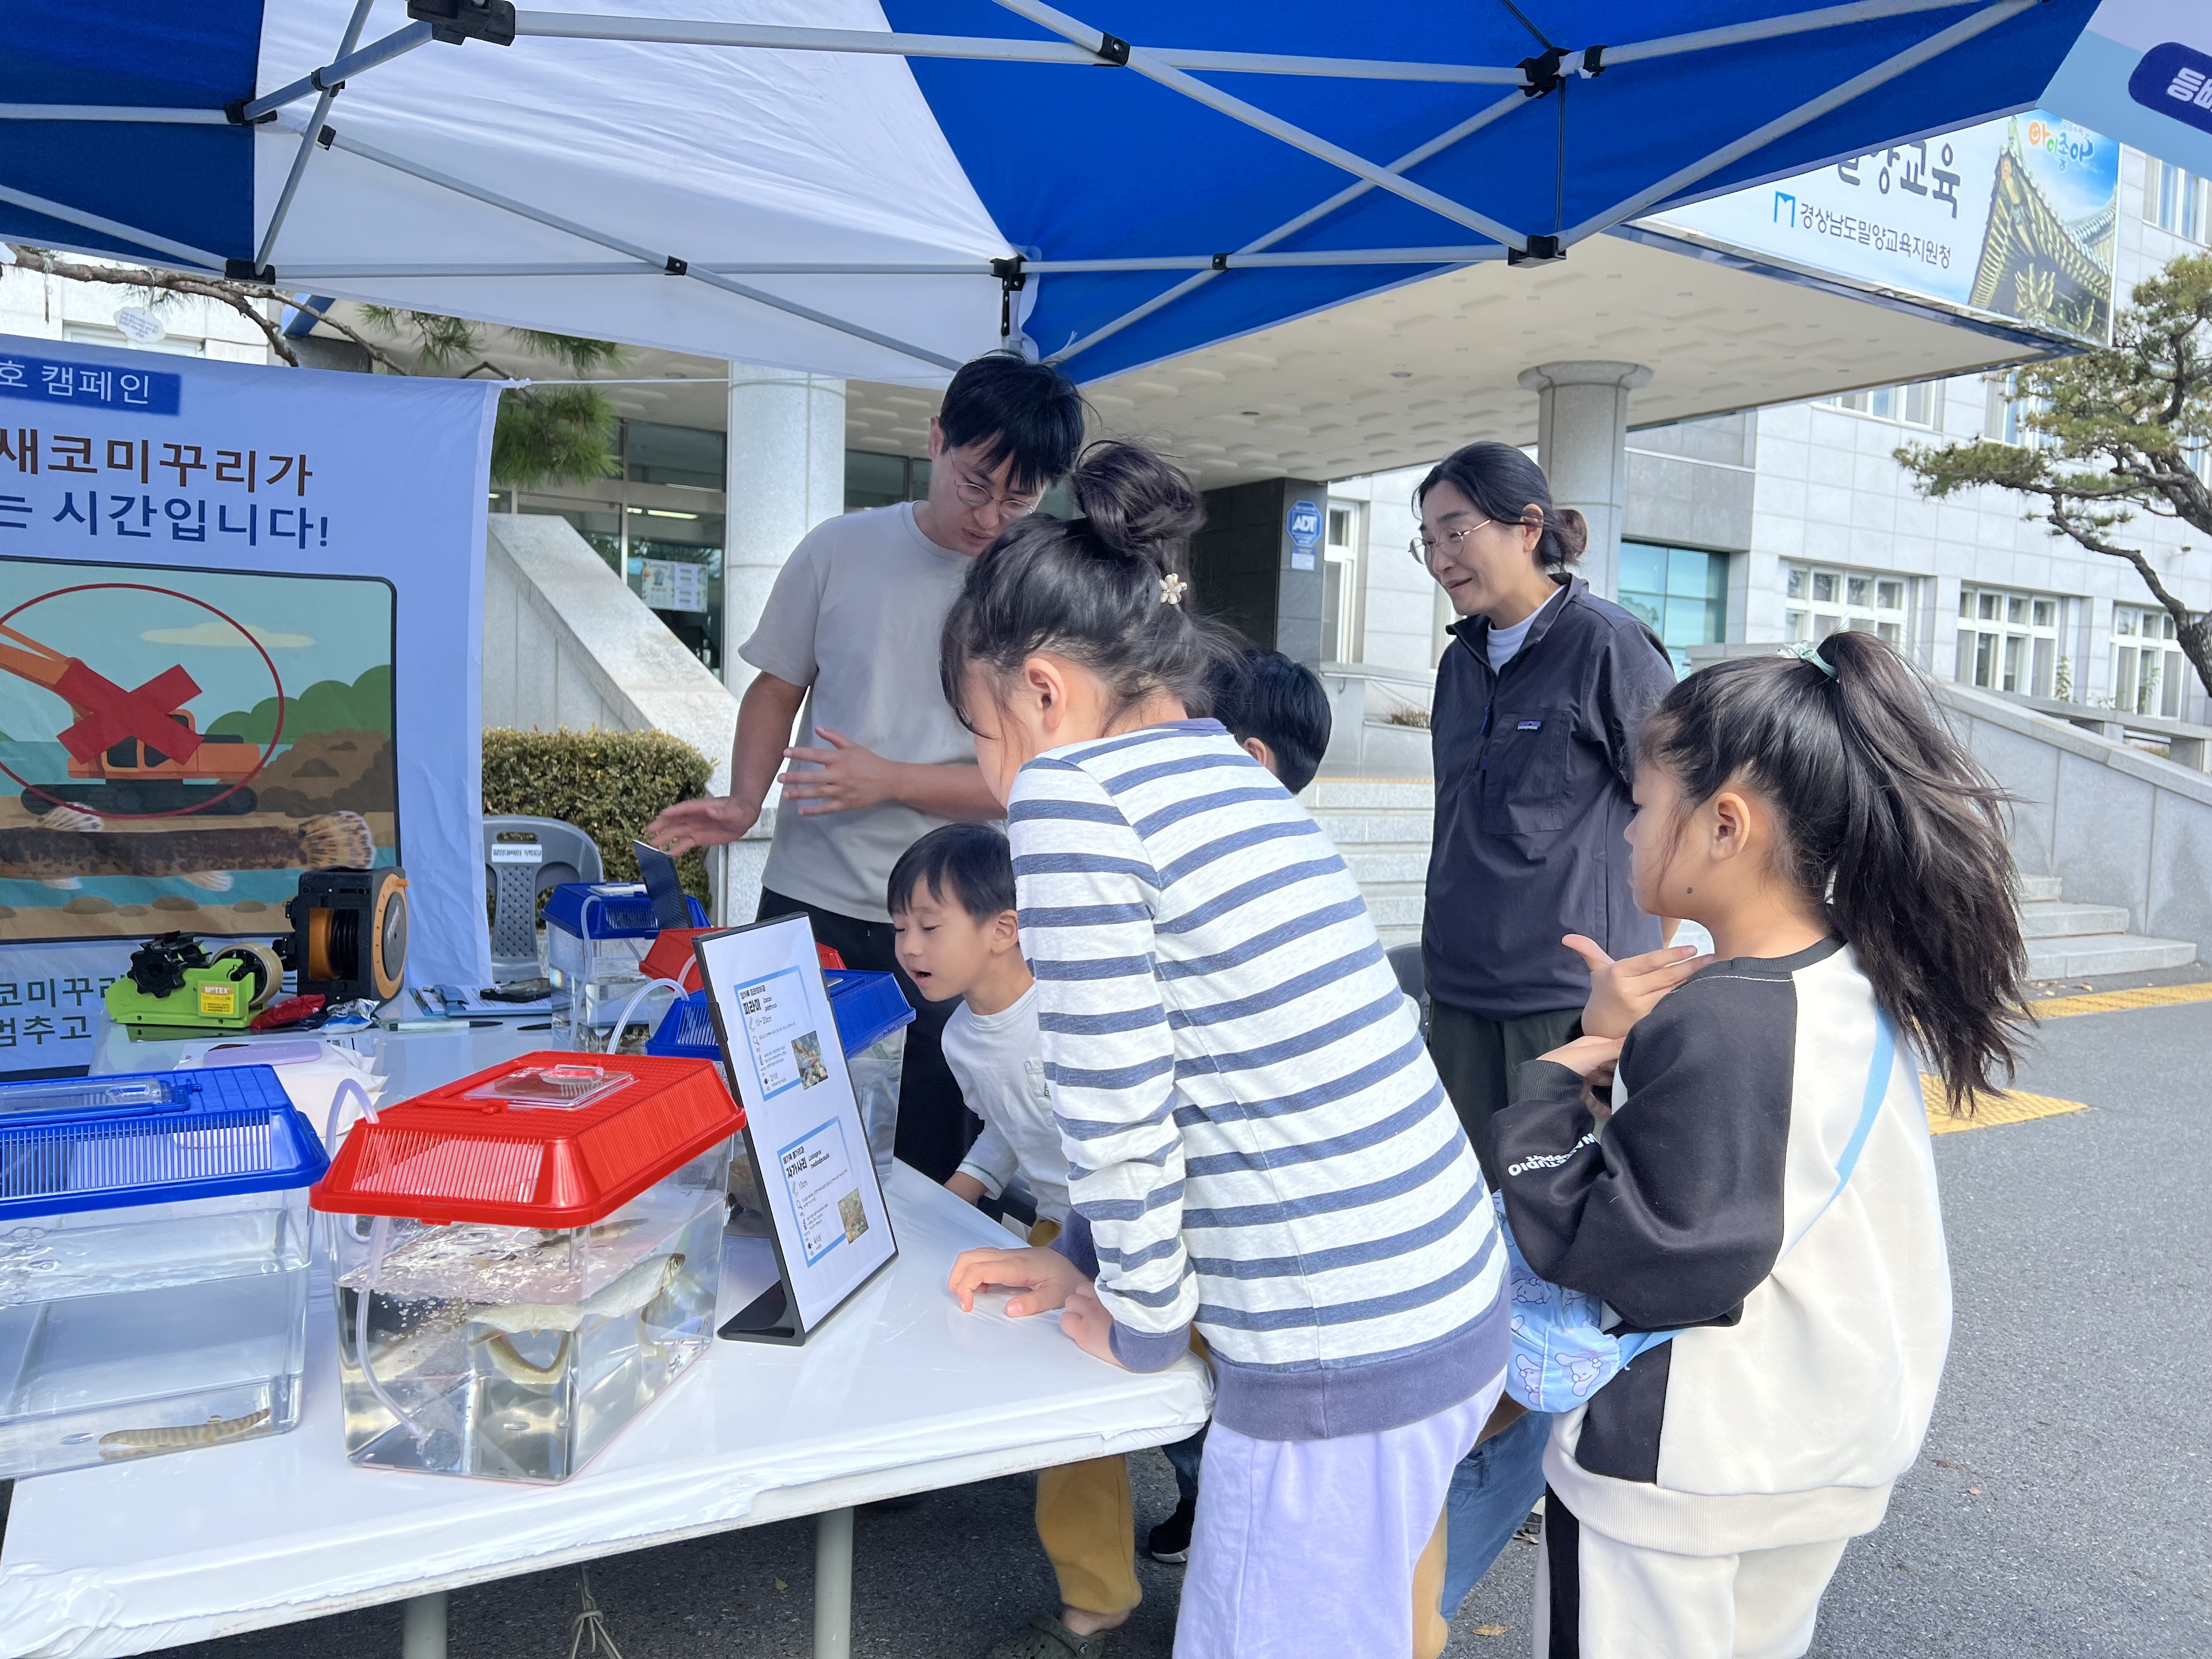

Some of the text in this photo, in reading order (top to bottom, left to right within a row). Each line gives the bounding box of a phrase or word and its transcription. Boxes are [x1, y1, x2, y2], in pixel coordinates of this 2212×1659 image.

[1801, 202, 1951, 269] 경상남도밀양교육지원청
[42, 365, 149, 404] 캠페인
[0, 428, 313, 496] 새코미꾸리가
[52, 490, 328, 550] 시간입니다!
[1292, 515, 1317, 533] ADT
[786, 1157, 807, 1178] 자가사리
